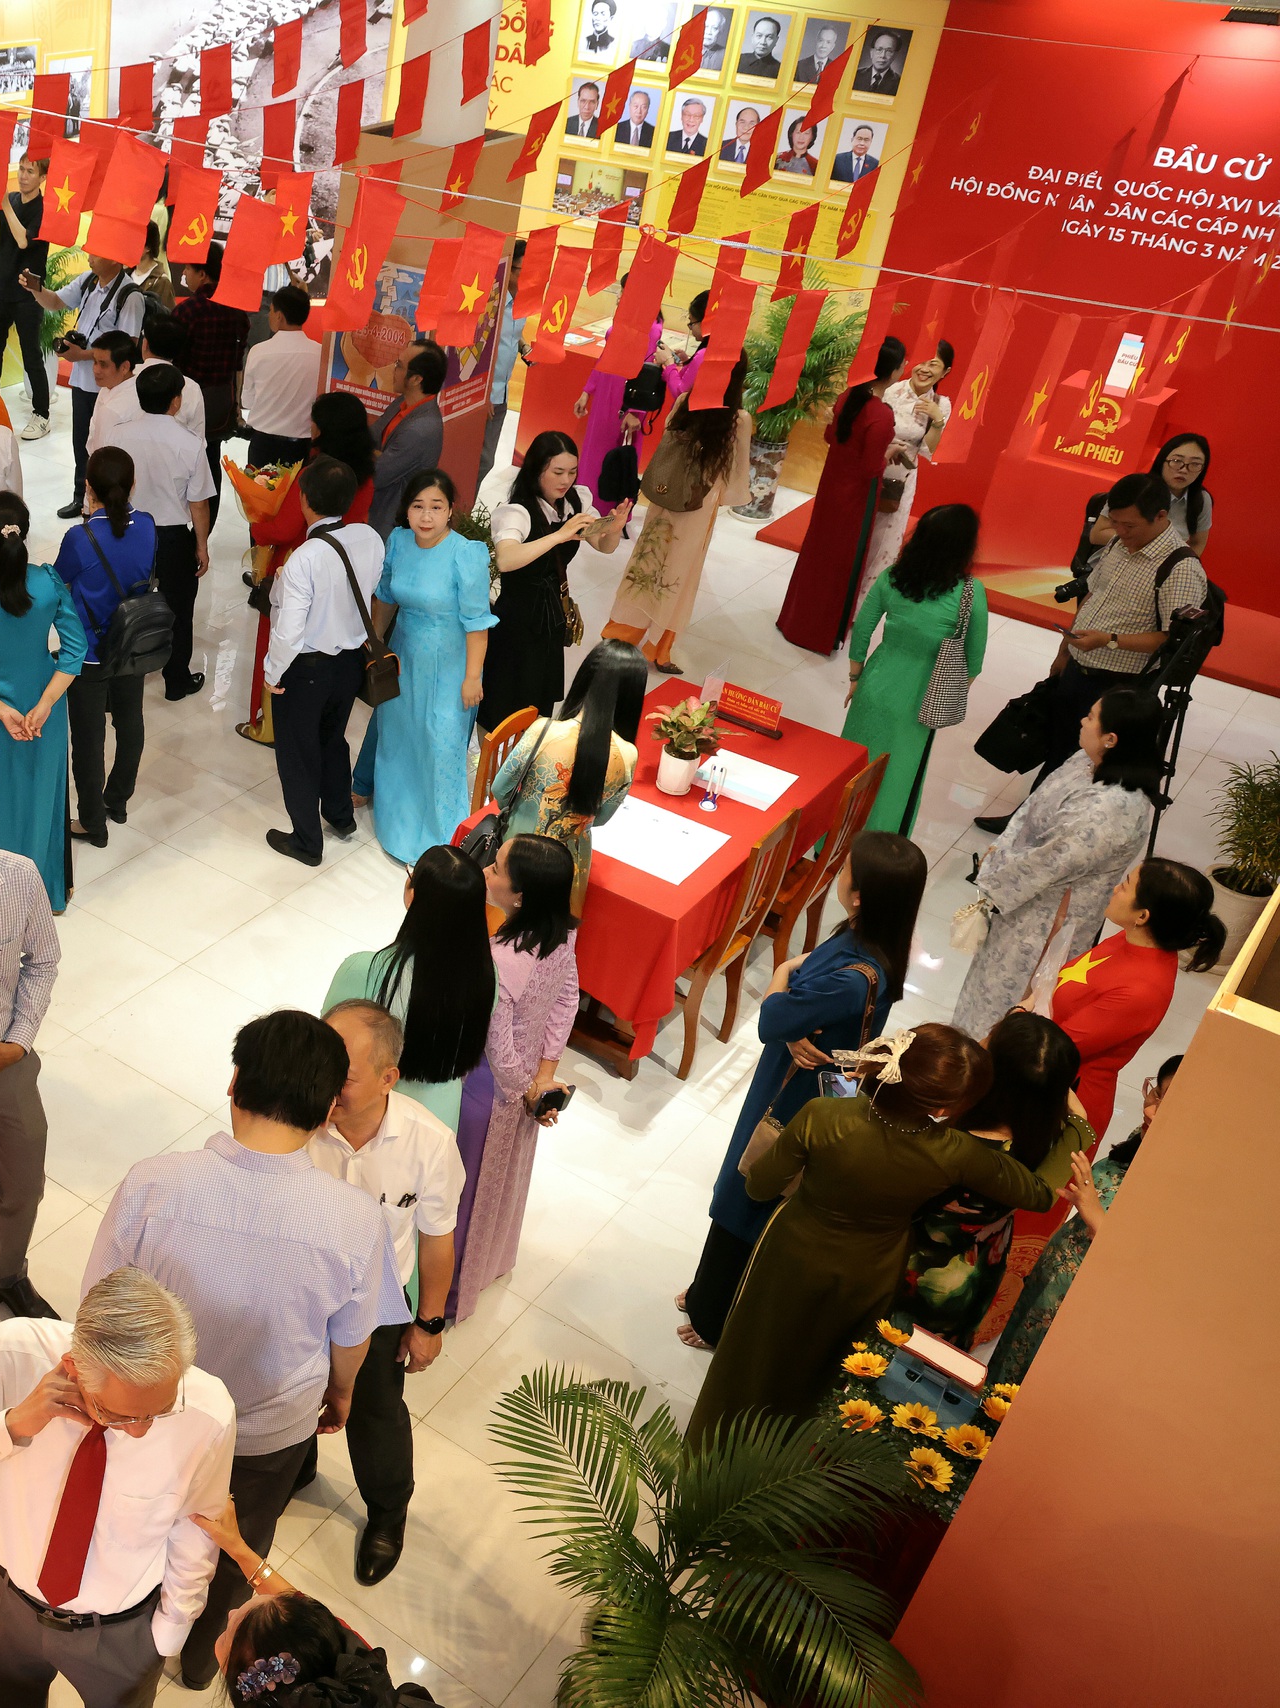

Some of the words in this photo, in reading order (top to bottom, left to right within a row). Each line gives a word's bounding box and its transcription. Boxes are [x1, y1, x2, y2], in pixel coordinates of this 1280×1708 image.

[1153, 144, 1218, 174] BẦU
[1224, 153, 1272, 180] CỬ
[950, 176, 983, 196] HỘI
[986, 182, 1042, 204] ĐỒNG
[1104, 202, 1147, 222] DÂN
[1151, 210, 1192, 229] CÁC
[1196, 216, 1238, 235] CẤP
[1028, 165, 1061, 185] ĐẠI
[1114, 179, 1173, 201] QUỐC
[1176, 188, 1215, 209] HỘI
[1217, 195, 1253, 214] XVI
[1061, 219, 1105, 238] GÀY
[1108, 226, 1126, 242] 15
[1130, 230, 1198, 255] THÁNG
[1200, 243, 1214, 258] 3
[1084, 442, 1124, 465] PHIẾU
